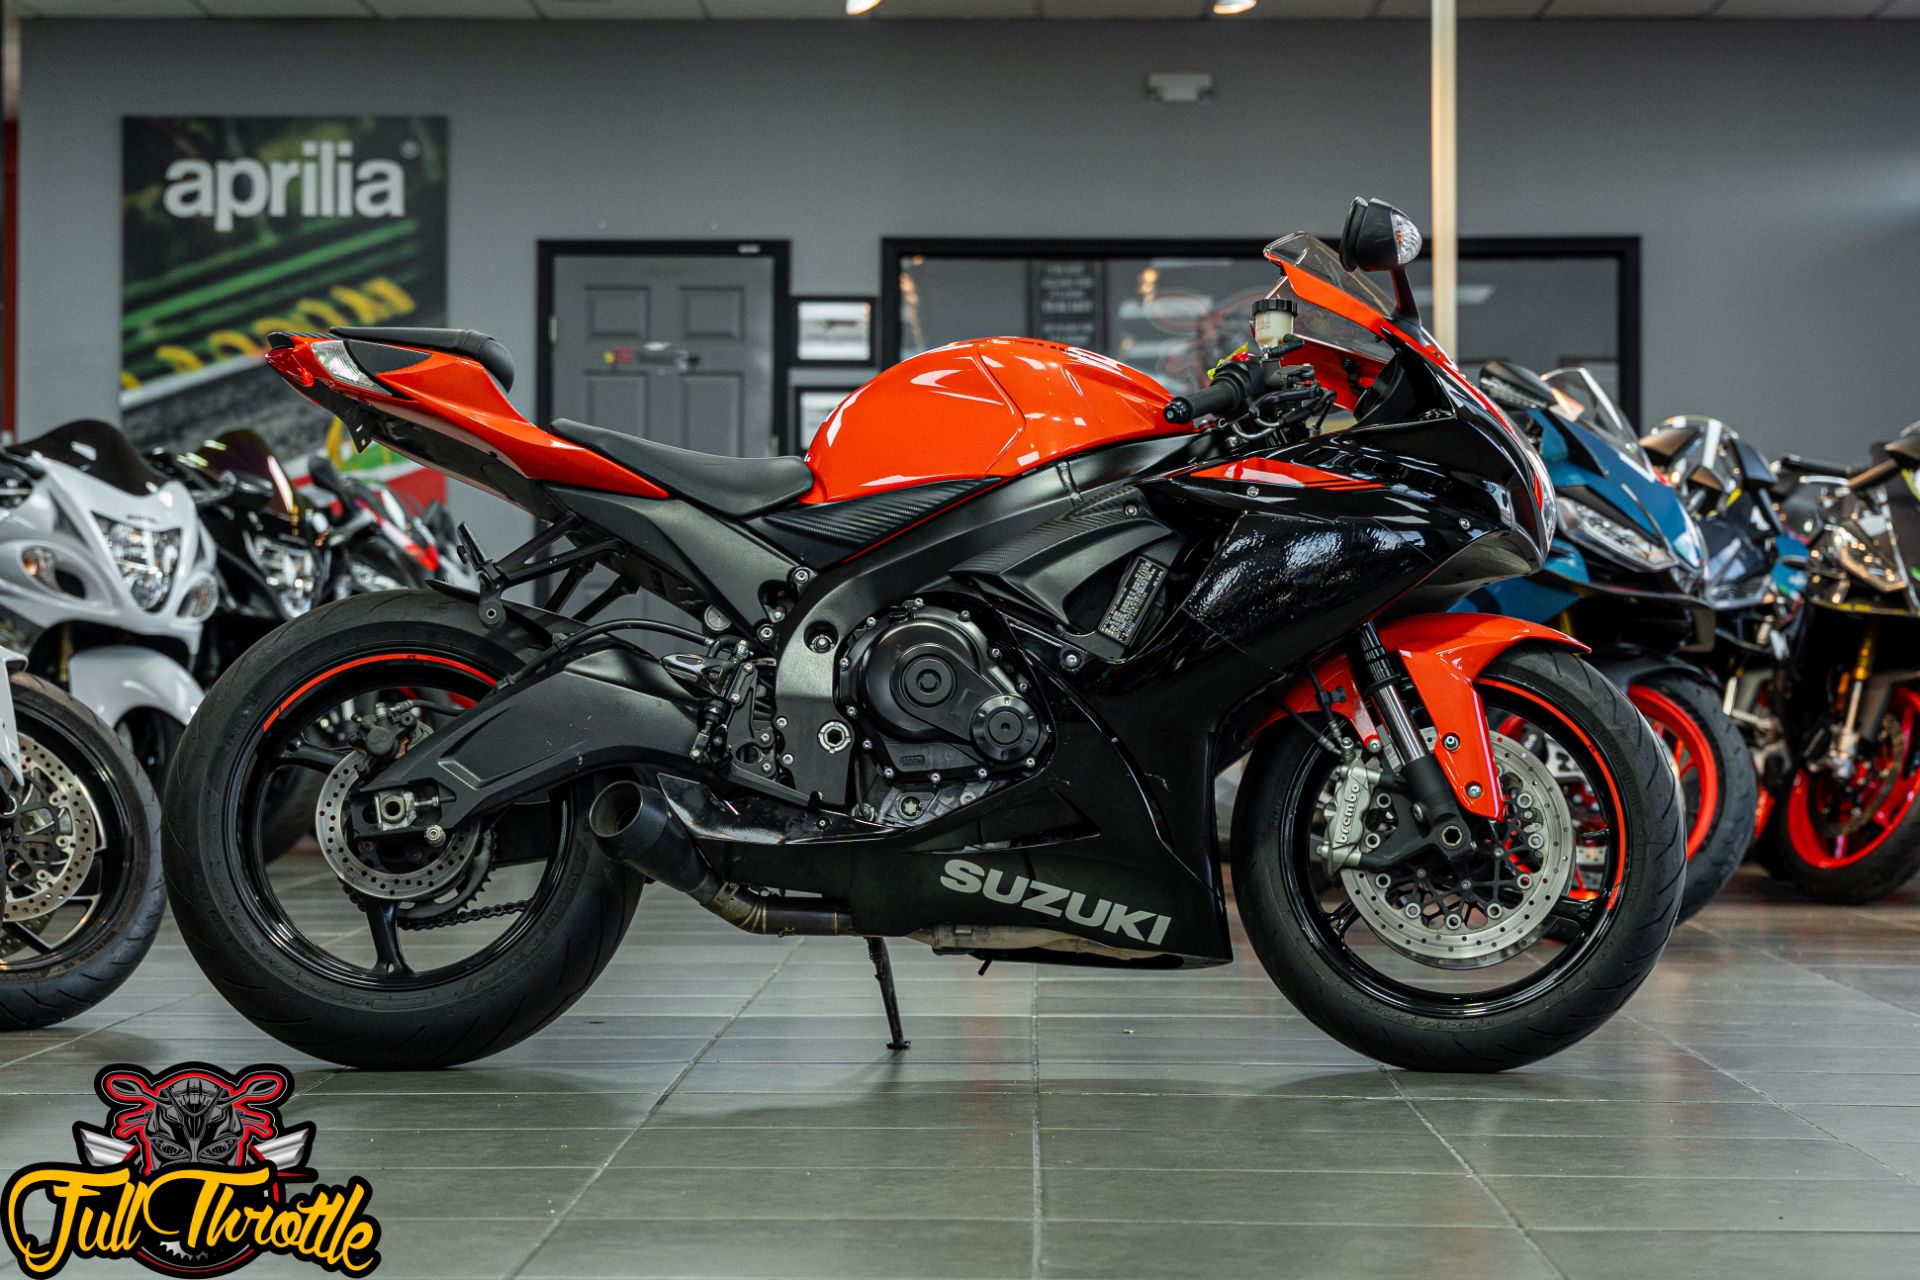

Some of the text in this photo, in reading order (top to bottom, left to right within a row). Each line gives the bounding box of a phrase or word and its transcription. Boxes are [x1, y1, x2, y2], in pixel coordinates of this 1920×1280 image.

[164, 140, 405, 232] aprilia
[1336, 784, 1361, 844] brembo
[940, 859, 1172, 945] SUZUKI
